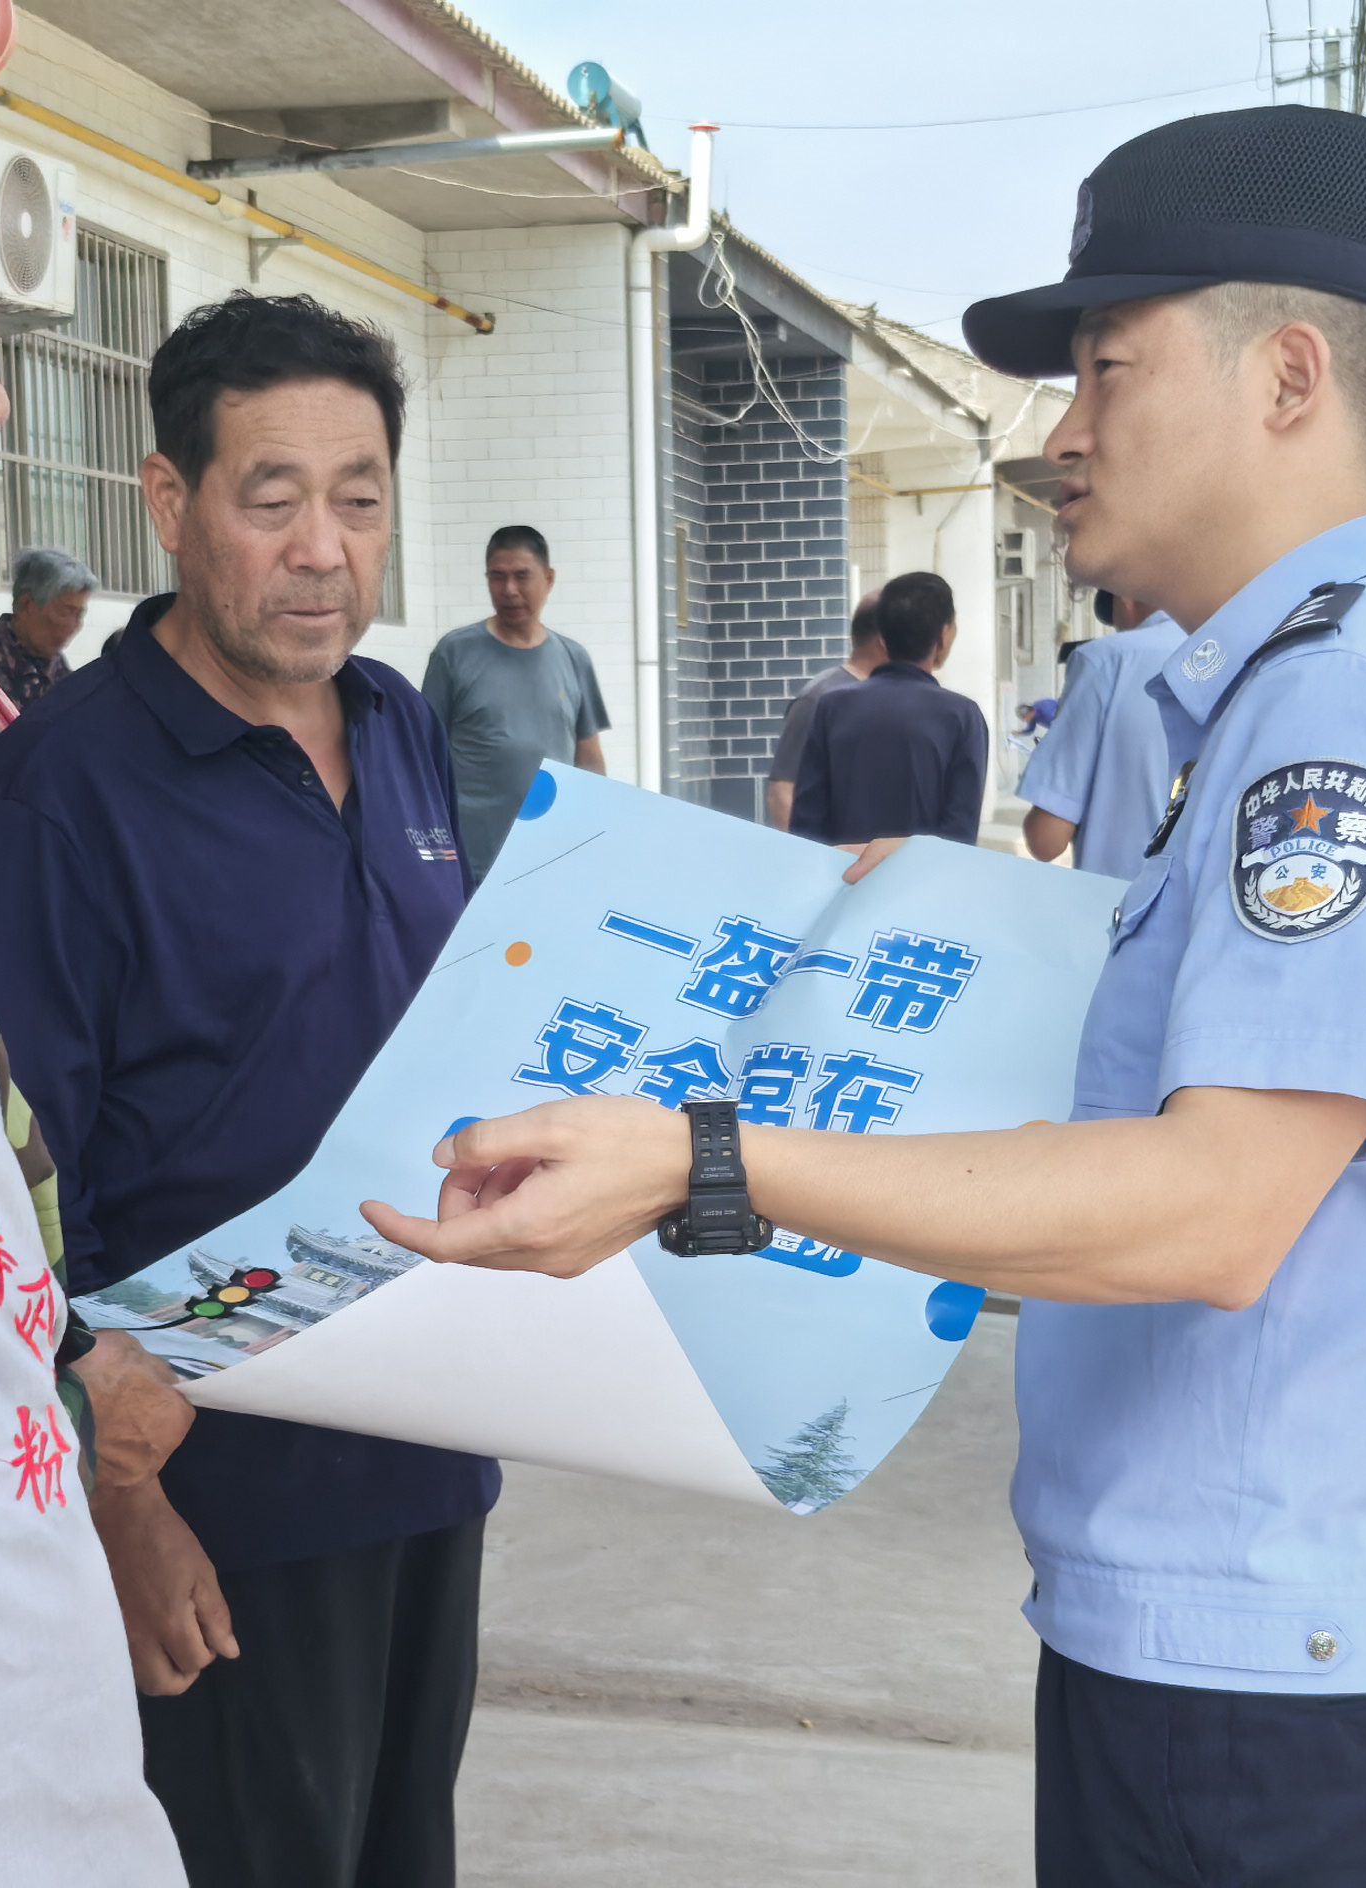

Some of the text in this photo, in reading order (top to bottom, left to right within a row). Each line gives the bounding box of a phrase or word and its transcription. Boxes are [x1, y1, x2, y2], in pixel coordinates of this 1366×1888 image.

[1270, 837, 1337, 860] POLICE
[598, 910, 980, 1034] 一盔一带
[512, 996, 924, 1134] 安全常在
